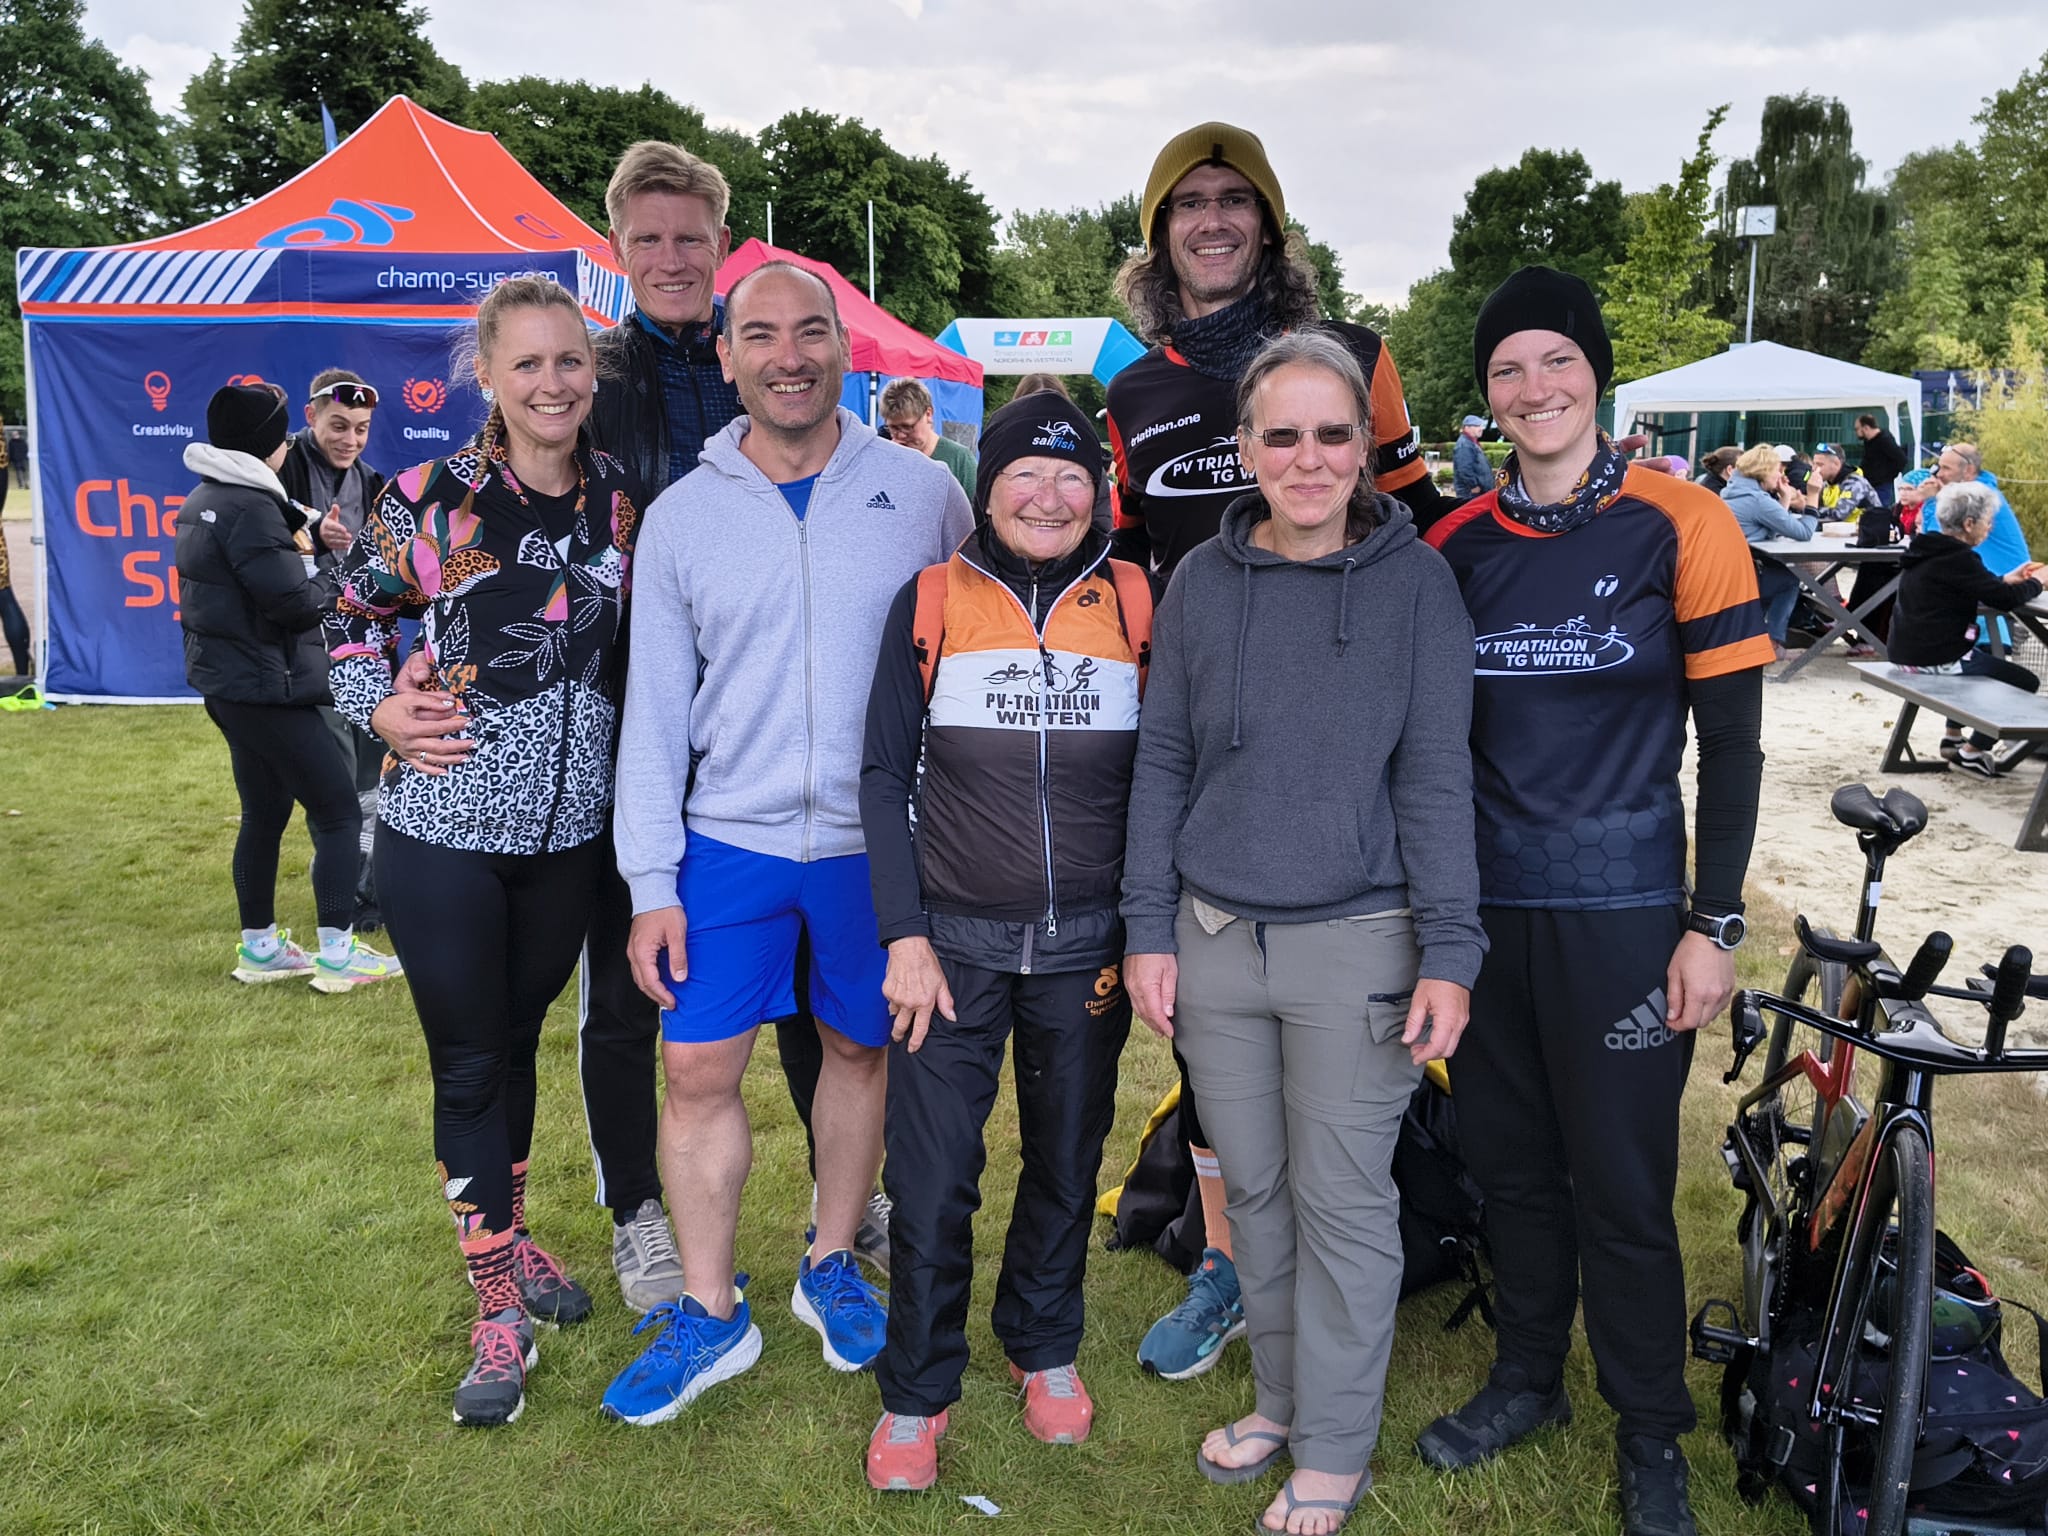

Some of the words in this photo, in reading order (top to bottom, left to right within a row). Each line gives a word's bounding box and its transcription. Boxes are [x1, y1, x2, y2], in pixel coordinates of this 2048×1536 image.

[376, 265, 559, 294] champ-syscm
[132, 424, 194, 438] Creativity
[403, 427, 450, 441] Quality
[1130, 413, 1201, 447] triathlon.one
[1031, 435, 1076, 452] sailfish
[1172, 460, 1194, 477] PV
[1211, 469, 1235, 484] TG
[866, 502, 896, 511] adidas
[1493, 638, 1588, 654] TRIATHLON
[1505, 654, 1528, 667] TG
[1532, 653, 1597, 667] WITTEN
[986, 692, 1100, 712] PV-TRIATHLON
[996, 710, 1092, 726] WITTEN
[1603, 1023, 1679, 1050] adida
